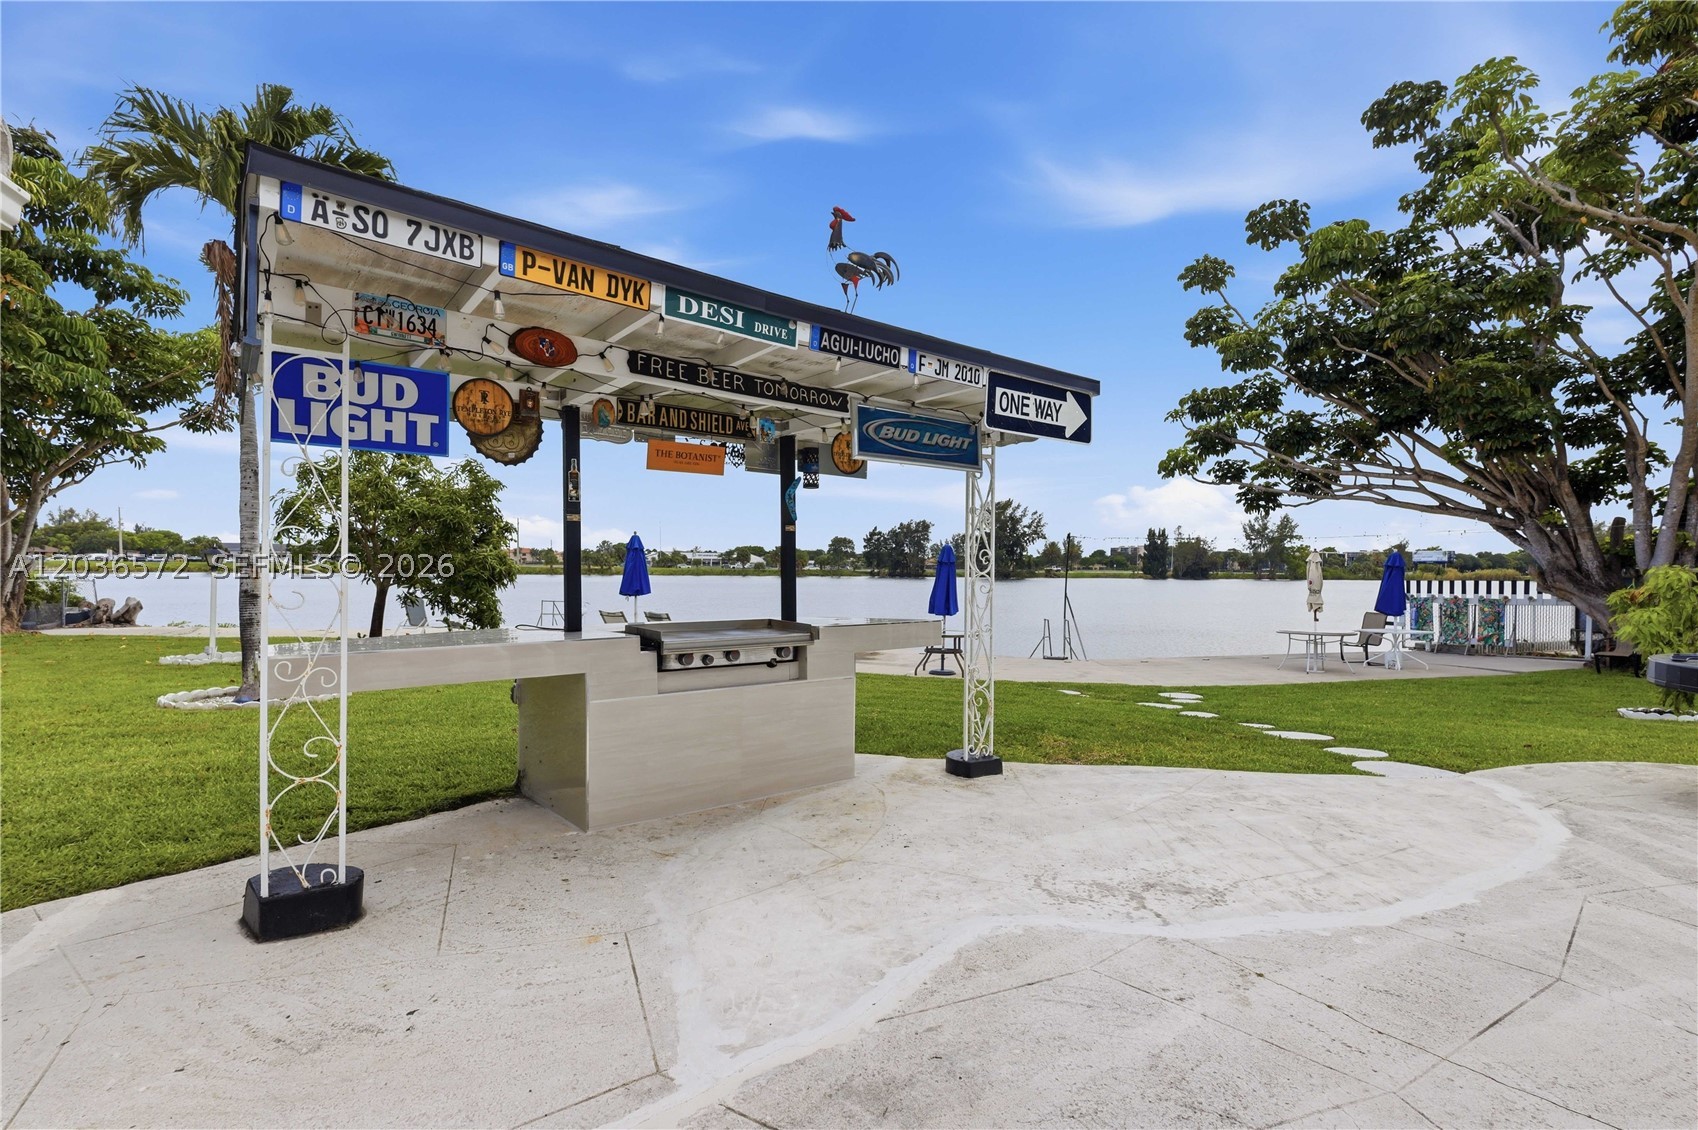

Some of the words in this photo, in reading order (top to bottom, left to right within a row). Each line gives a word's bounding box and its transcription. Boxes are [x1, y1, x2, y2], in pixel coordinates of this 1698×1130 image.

[287, 204, 296, 214] D
[406, 219, 475, 261] 7JXB
[501, 262, 514, 272] GB
[522, 251, 594, 293] P-VAN
[606, 273, 644, 305] DYK
[392, 301, 441, 316] GEORGIA
[677, 294, 746, 329] DESI
[754, 321, 788, 340] DRIVE
[821, 331, 899, 364] AGUI-LUCHO
[303, 363, 419, 410] BUD
[637, 354, 689, 382] FREE
[697, 366, 745, 391] BEER
[754, 378, 843, 408] TOMORROW
[954, 363, 980, 385] 2010
[278, 398, 439, 447] LIGHT
[627, 402, 655, 425] BAR
[659, 407, 687, 430] AND
[690, 410, 733, 435] SHIELD
[736, 421, 750, 432] AVE
[999, 390, 1030, 417] ONE
[1034, 398, 1063, 423] WAY
[879, 424, 920, 443] BUD
[923, 432, 973, 452] LIGHT
[655, 448, 674, 459] THE
[675, 451, 718, 462] BOTANIST
